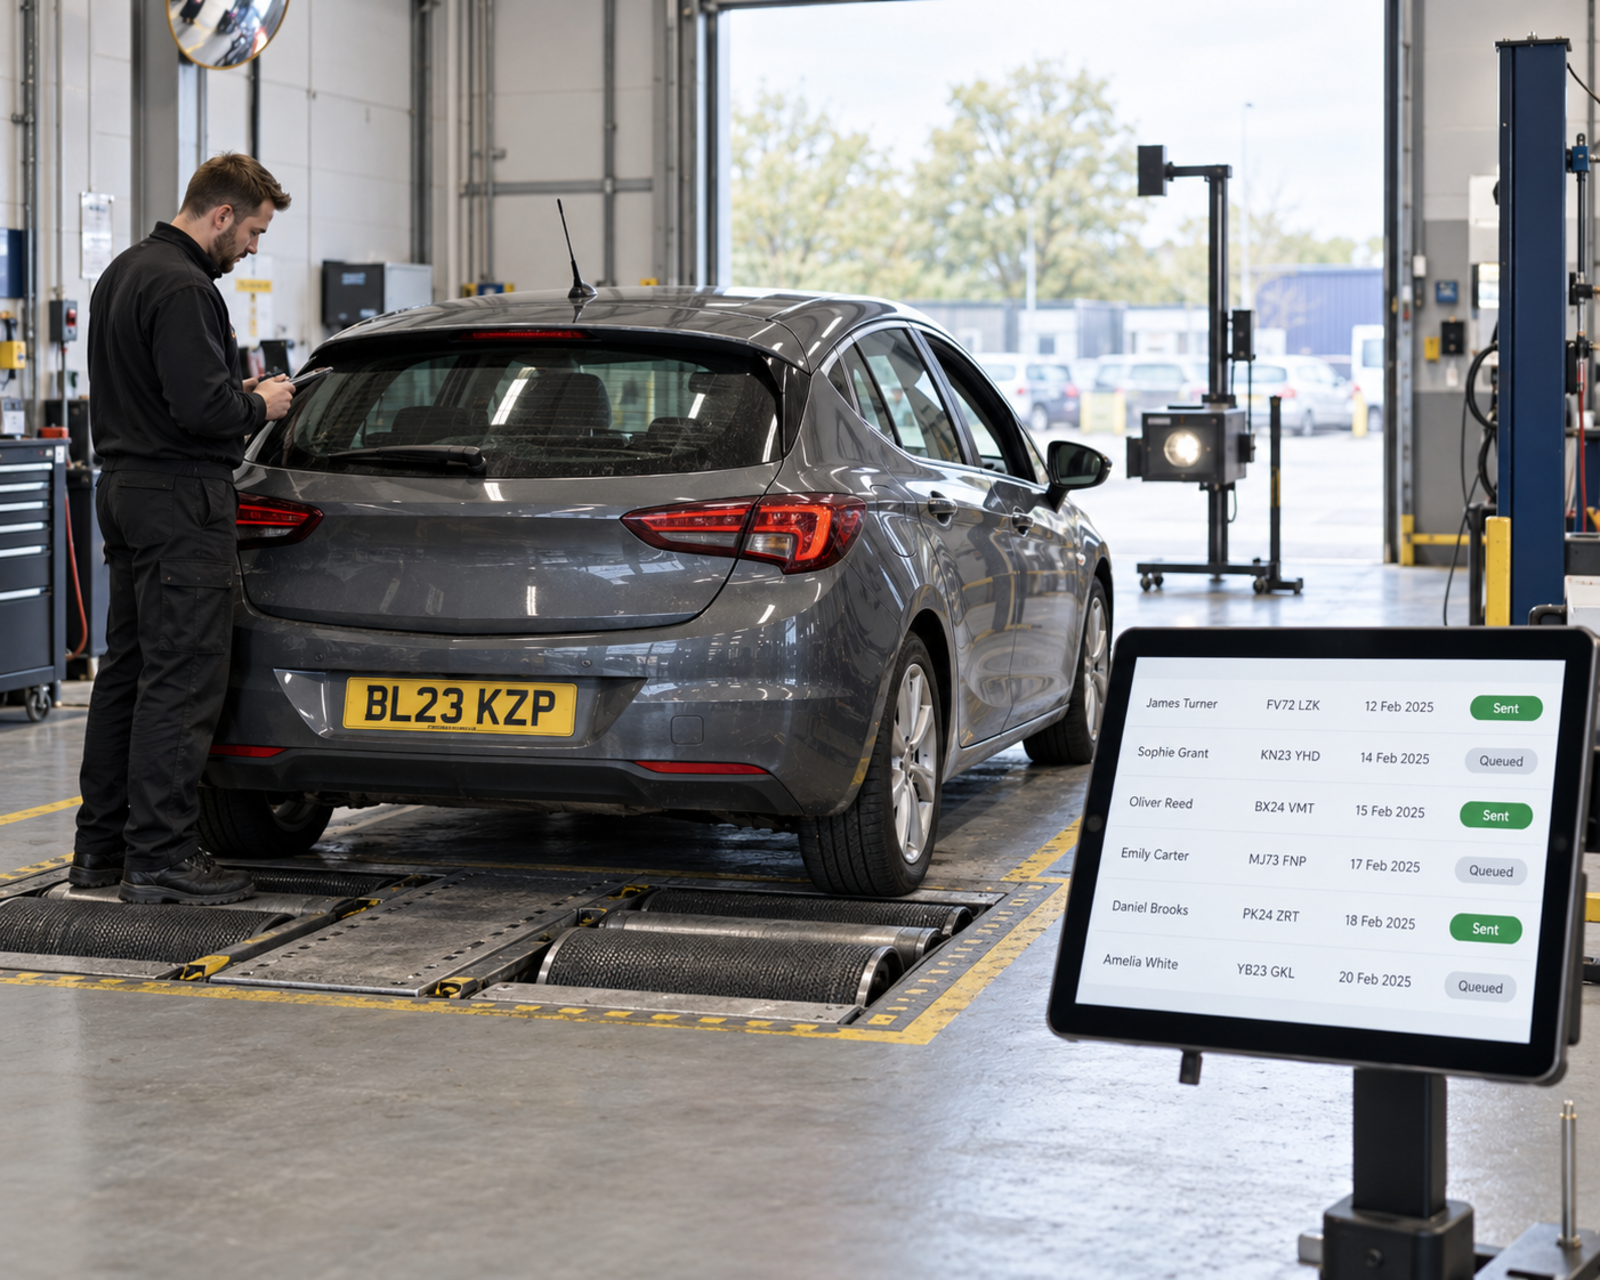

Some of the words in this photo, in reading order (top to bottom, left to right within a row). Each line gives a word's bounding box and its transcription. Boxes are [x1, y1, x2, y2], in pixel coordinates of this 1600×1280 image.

[364, 684, 464, 724] BL23
[476, 687, 556, 727] KZP
[1145, 697, 1181, 709] James
[1183, 697, 1219, 710] Turner
[1266, 698, 1296, 711] FV72
[1298, 699, 1321, 711] LZK
[1365, 700, 1378, 712] 12
[1380, 700, 1402, 713] Feb
[1404, 701, 1434, 713] 2025
[1493, 702, 1520, 714] Sent
[1137, 745, 1176, 760] Sophie
[1177, 746, 1209, 759] Grant
[1260, 749, 1292, 761] KN23
[1294, 750, 1321, 762] YHD
[1360, 751, 1373, 763] 14
[1376, 752, 1398, 764] Feb
[1400, 752, 1430, 765] 2025
[1479, 754, 1524, 768] Queued
[1129, 795, 1163, 808] Oliver
[1164, 797, 1194, 810] Reed
[1254, 800, 1285, 813] BX24
[1288, 802, 1315, 814] VMT
[1356, 804, 1368, 817] 15
[1371, 804, 1393, 818] Feb
[1395, 805, 1425, 819] 2025
[1482, 809, 1510, 822] Sent
[1121, 846, 1152, 863] Emily
[1153, 848, 1190, 862] Carter
[1248, 853, 1280, 866] MJ73
[1282, 854, 1307, 867] FNP
[1350, 858, 1363, 870] 17
[1365, 858, 1388, 872] Feb
[1390, 859, 1421, 874] 2025
[1469, 864, 1514, 878] Queued
[1112, 899, 1148, 914] Daniel
[1149, 902, 1189, 916] Brooks
[1242, 907, 1273, 921] PK24
[1276, 909, 1300, 923] ZRT
[1345, 914, 1358, 927] 18
[1360, 914, 1383, 929] Feb
[1385, 916, 1416, 931] 2025
[1472, 921, 1500, 936] Sent
[1102, 953, 1142, 968] Amelia
[1145, 956, 1179, 971] White
[1237, 963, 1268, 977] YB23
[1270, 965, 1295, 979] GKL
[1338, 970, 1354, 984] 20
[1356, 971, 1379, 986] Feb
[1381, 973, 1412, 988] 2025
[1458, 979, 1504, 995] Queued
